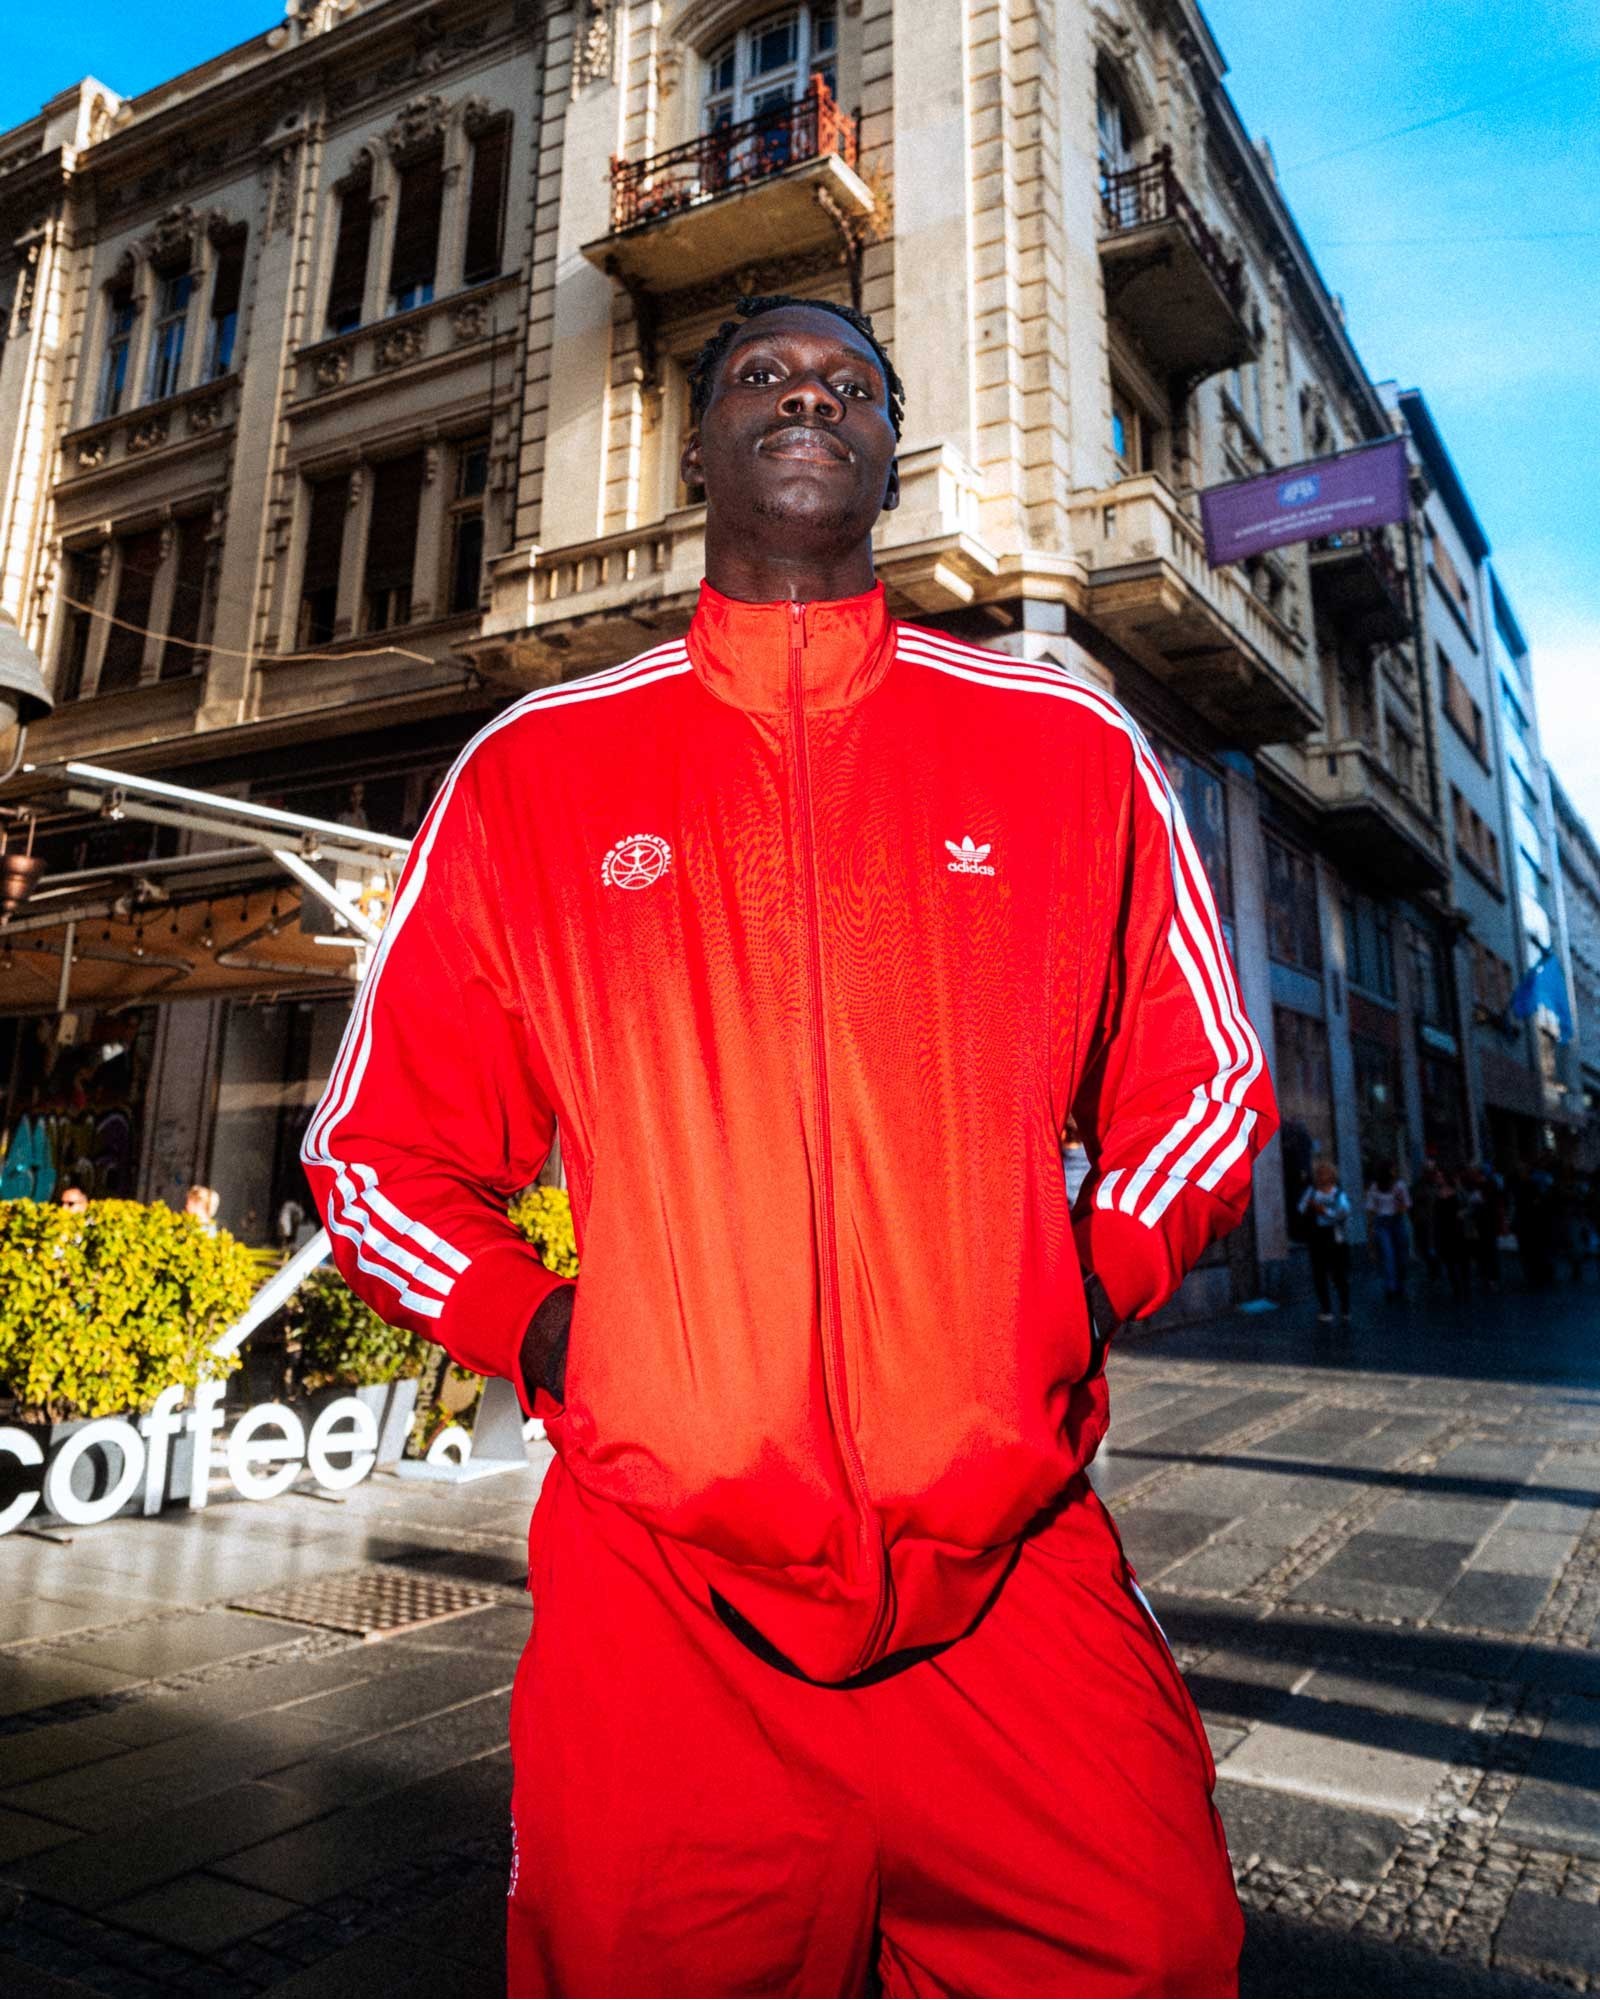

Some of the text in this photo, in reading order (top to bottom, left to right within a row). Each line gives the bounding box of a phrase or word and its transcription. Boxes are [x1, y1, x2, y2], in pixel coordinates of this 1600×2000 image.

[601, 833, 673, 887] PARIS BASKETBALL
[947, 861, 996, 877] adidas
